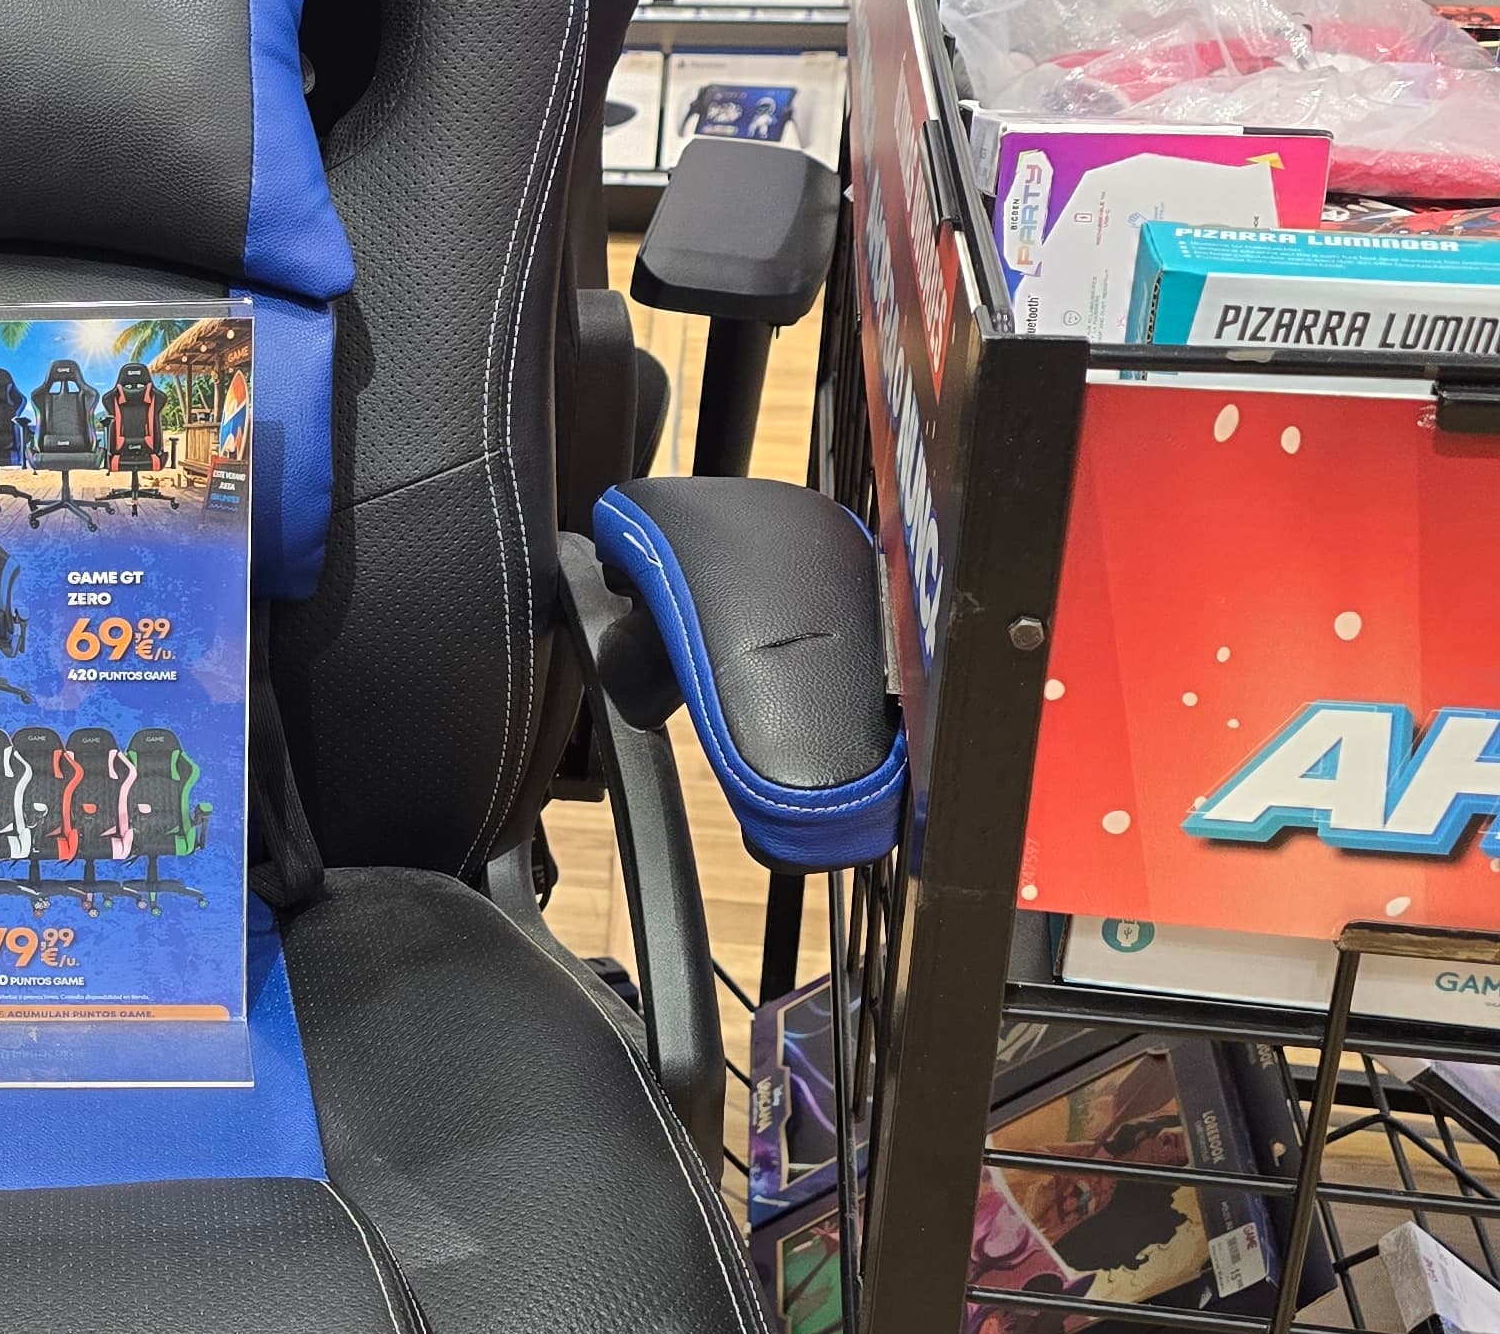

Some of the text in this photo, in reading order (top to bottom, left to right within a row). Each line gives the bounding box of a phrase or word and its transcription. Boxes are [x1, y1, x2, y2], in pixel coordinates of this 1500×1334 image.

[1010, 197, 1021, 231] BIGBEN
[1016, 164, 1043, 266] PARTY
[1213, 304, 1371, 348] PIZARRA
[227, 346, 249, 363] GAME
[67, 571, 144, 584] GAME GT
[67, 592, 111, 605] ZERO
[67, 669, 177, 680] 420 PUNTOS GAME
[10, 977, 51, 986] PUNTOS
[53, 977, 84, 986] GAME
[1202, 1109, 1226, 1165] LOREBOOK
